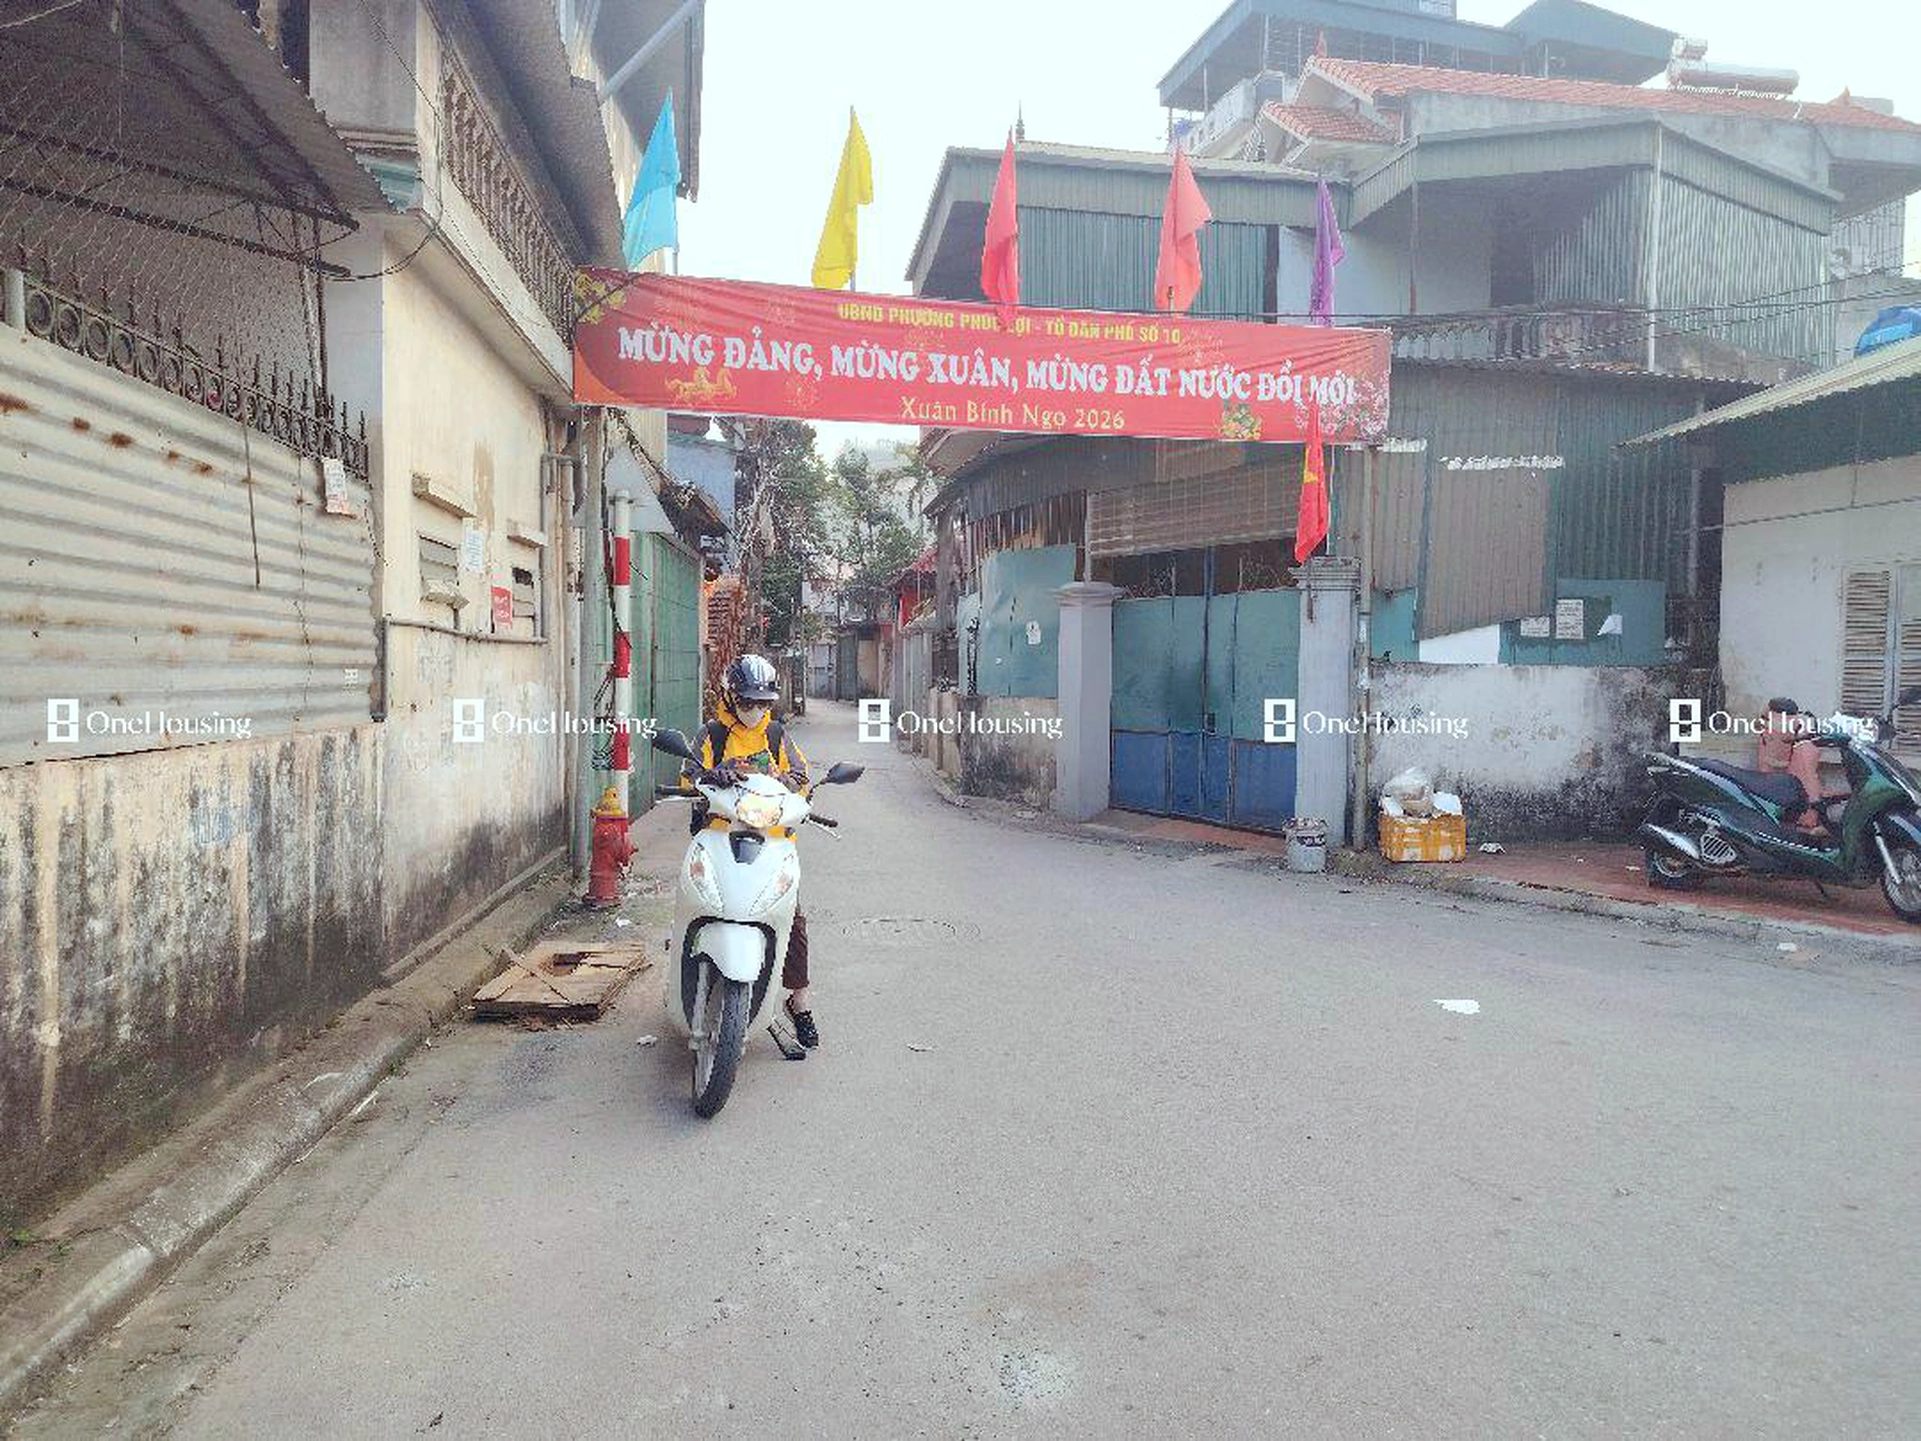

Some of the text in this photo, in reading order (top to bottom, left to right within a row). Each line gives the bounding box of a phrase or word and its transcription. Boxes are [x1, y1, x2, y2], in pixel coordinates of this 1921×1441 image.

[838, 303, 883, 323] UBND
[888, 305, 954, 328] PHƯỜNG
[1139, 321, 1159, 343] SỐ
[1163, 327, 1181, 344] 10
[618, 320, 1358, 405] MỪNG ĐẢNG, MỪNG XUÂN, MỪNG ĐẤT NƯỚC ĐỔI MỚI
[901, 396, 1125, 430] Xuân Bính Ngọ 2026
